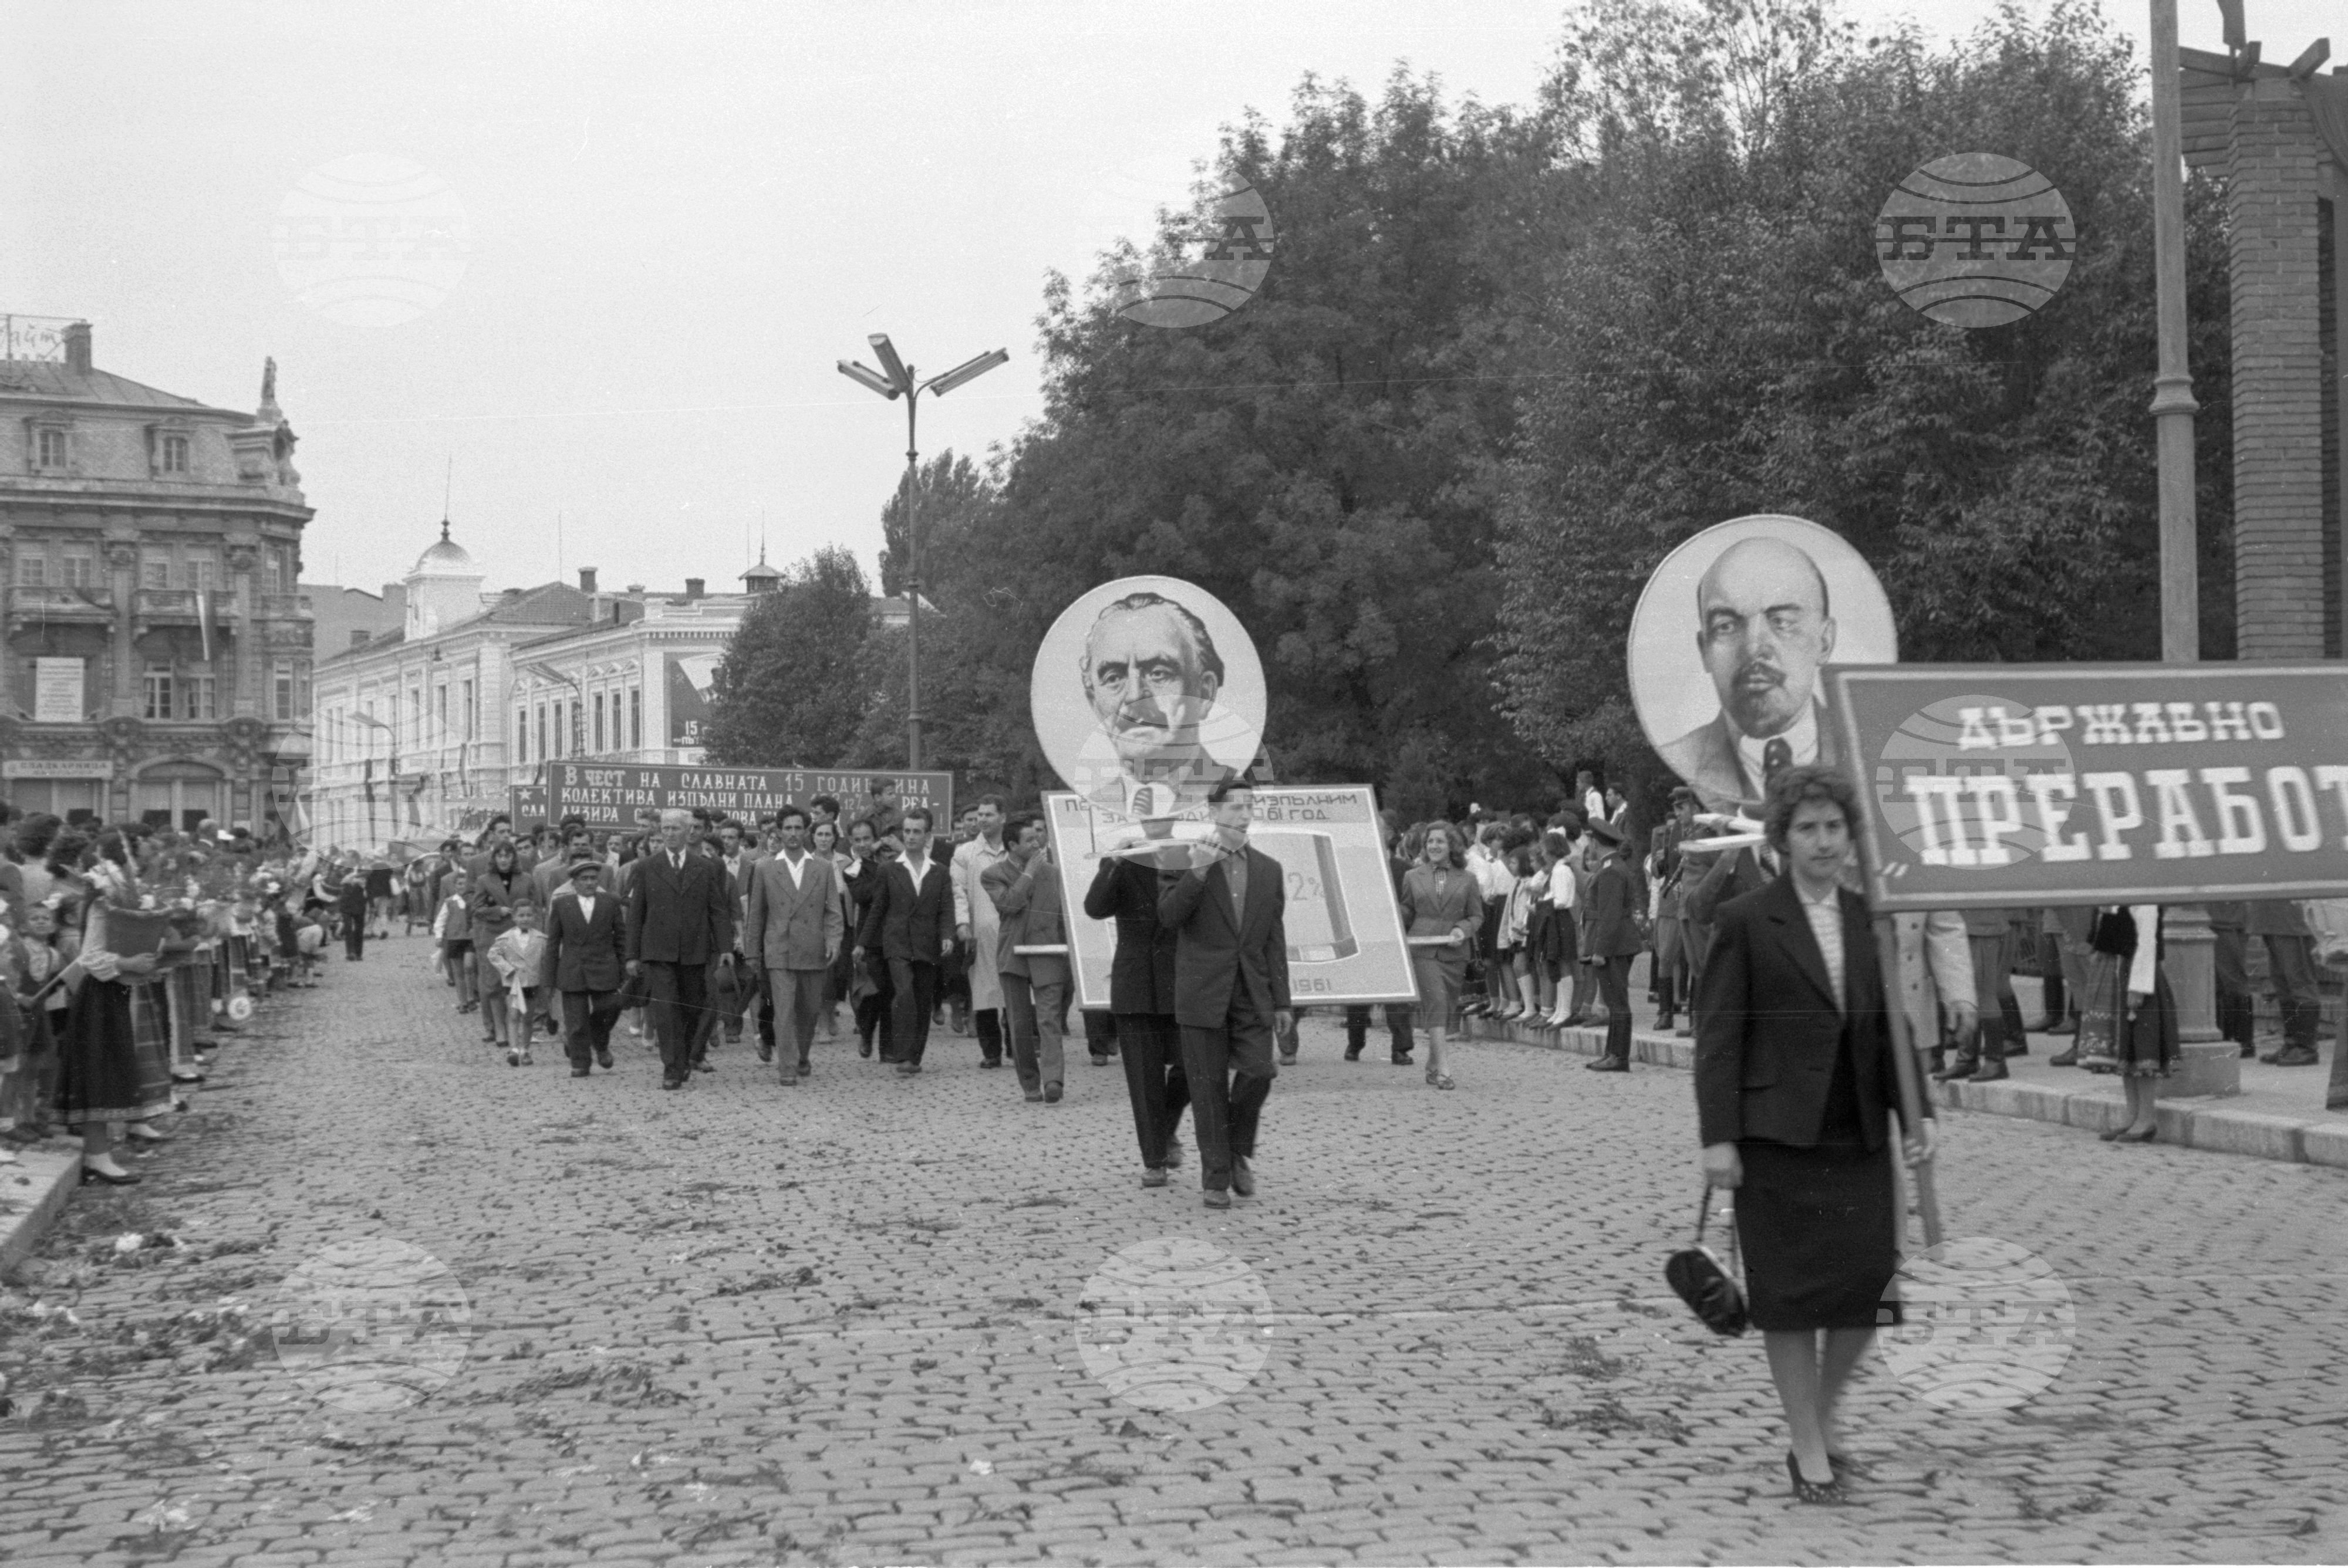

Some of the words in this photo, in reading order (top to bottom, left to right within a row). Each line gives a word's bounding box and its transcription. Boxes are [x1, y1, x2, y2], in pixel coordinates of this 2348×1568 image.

[686, 720, 697, 735] 15
[1958, 702, 2285, 749] ДЪРЖАВНО
[565, 765, 578, 786] В
[585, 769, 626, 787] ЧЕСТ
[640, 772, 661, 788] НА
[681, 773, 768, 790] СЛАВНАТА
[785, 773, 804, 792] 15
[561, 787, 656, 806] КОЛЕКТИВА
[667, 790, 737, 807] ИЗПЪЛНИ
[743, 792, 793, 809] ПЛАНА
[1290, 809, 1331, 820] ГОД
